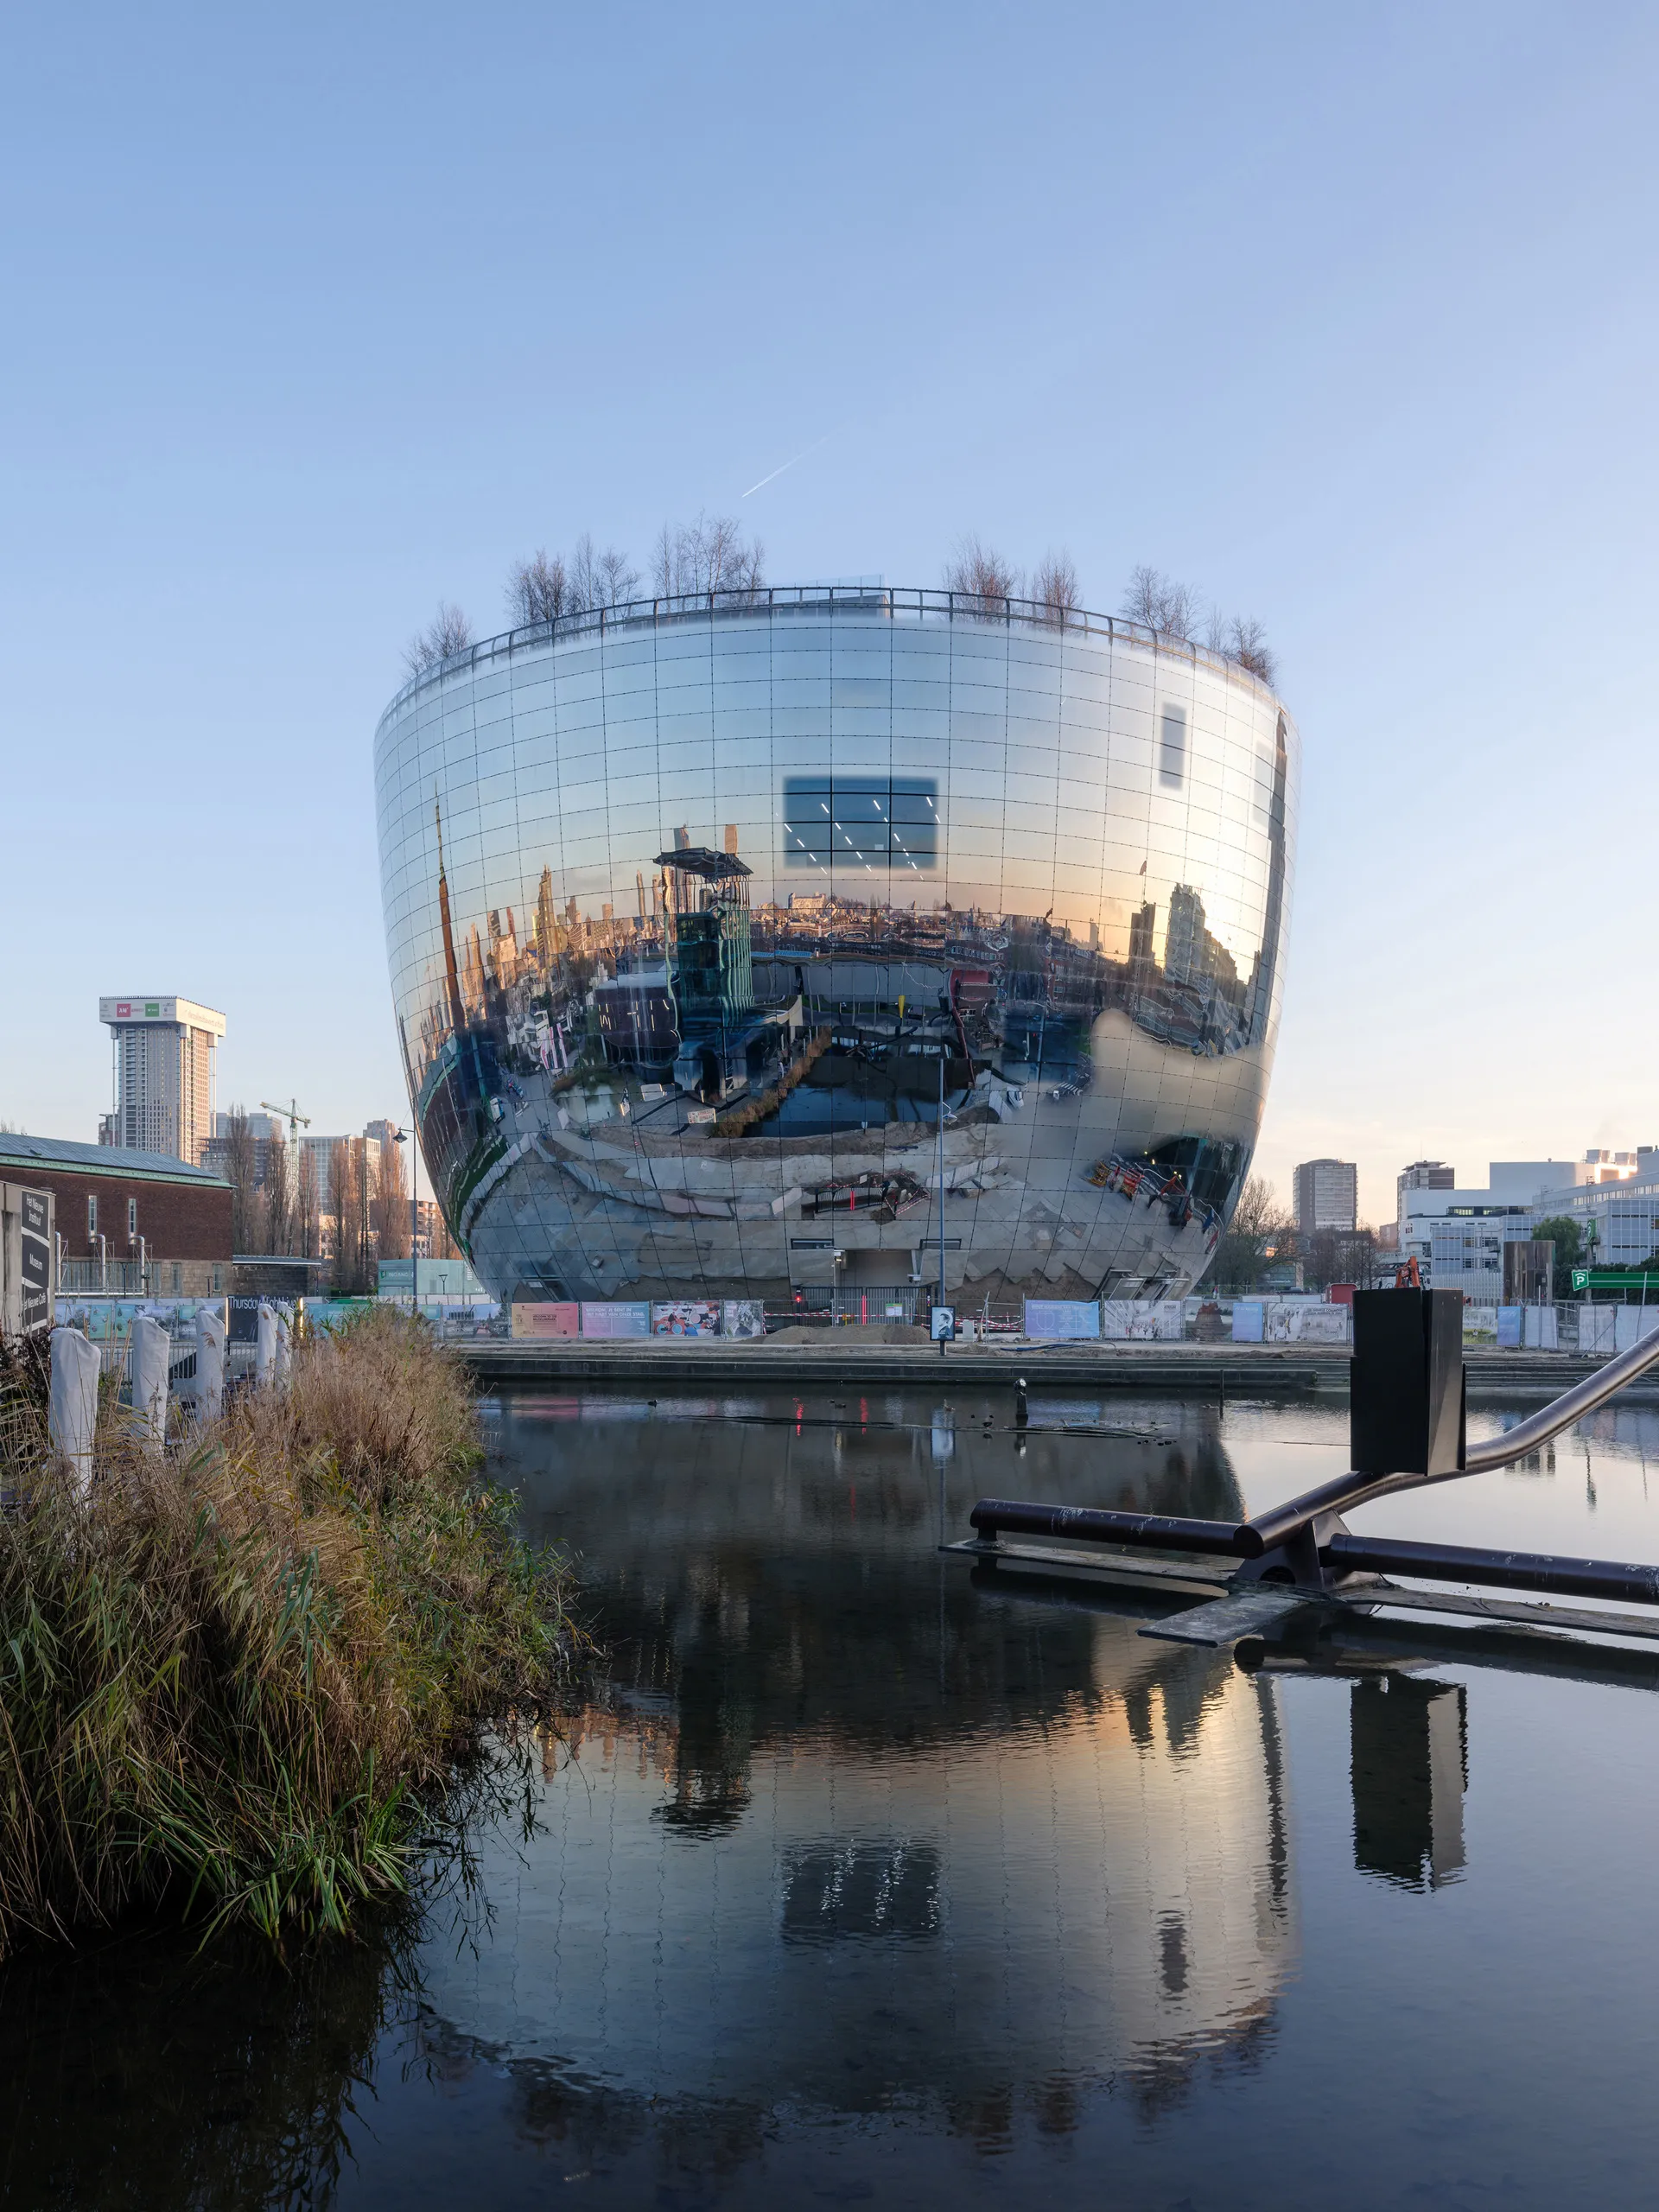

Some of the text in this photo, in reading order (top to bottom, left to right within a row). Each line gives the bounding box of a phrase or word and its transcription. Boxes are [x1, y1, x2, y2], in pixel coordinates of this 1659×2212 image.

[32, 1198, 44, 1214] Nieuwe
[29, 1210, 41, 1226] Instituut
[29, 1253, 43, 1271] Museum
[1576, 1276, 1585, 1286] P
[27, 1296, 39, 1309] Nieuwe
[228, 1296, 262, 1309] Thursday
